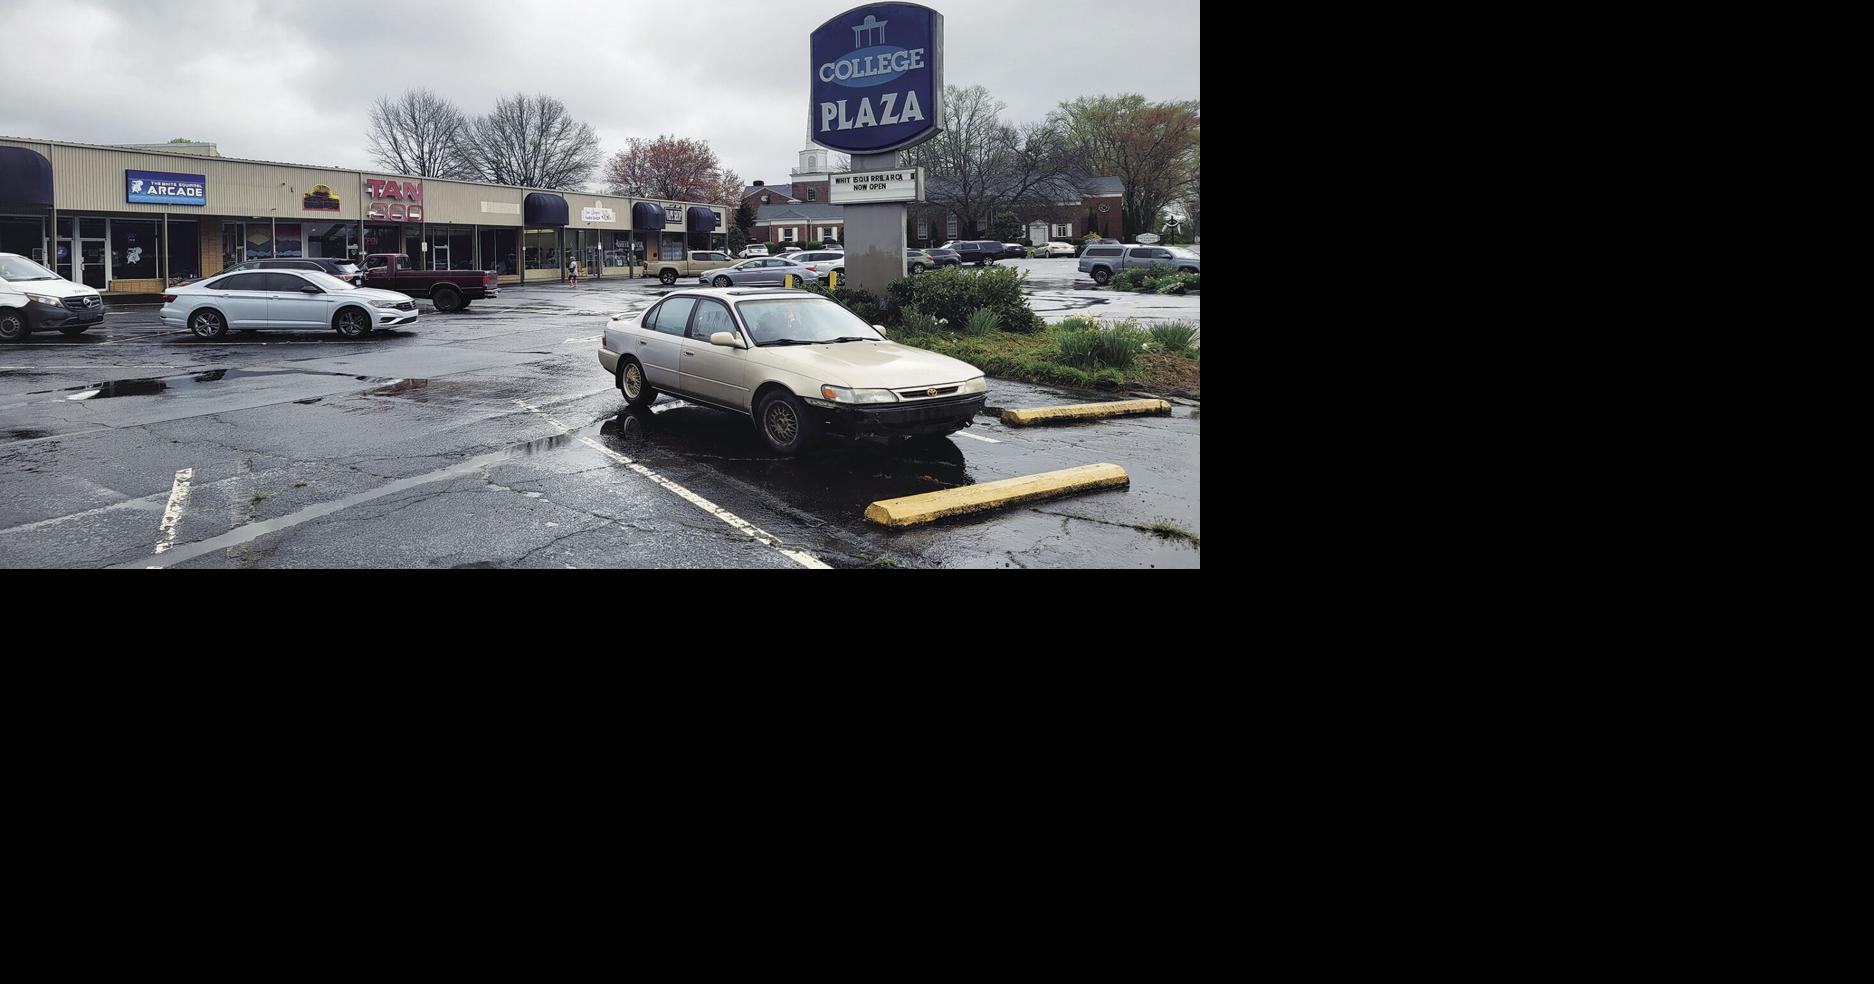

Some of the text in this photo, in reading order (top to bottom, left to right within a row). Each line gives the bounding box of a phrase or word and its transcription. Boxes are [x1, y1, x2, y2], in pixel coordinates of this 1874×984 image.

[818, 47, 925, 83] COLLEGE
[819, 90, 925, 132] PLAZA
[147, 186, 203, 197] ARCADE
[366, 179, 423, 201] TAN
[869, 182, 887, 190] OPEN
